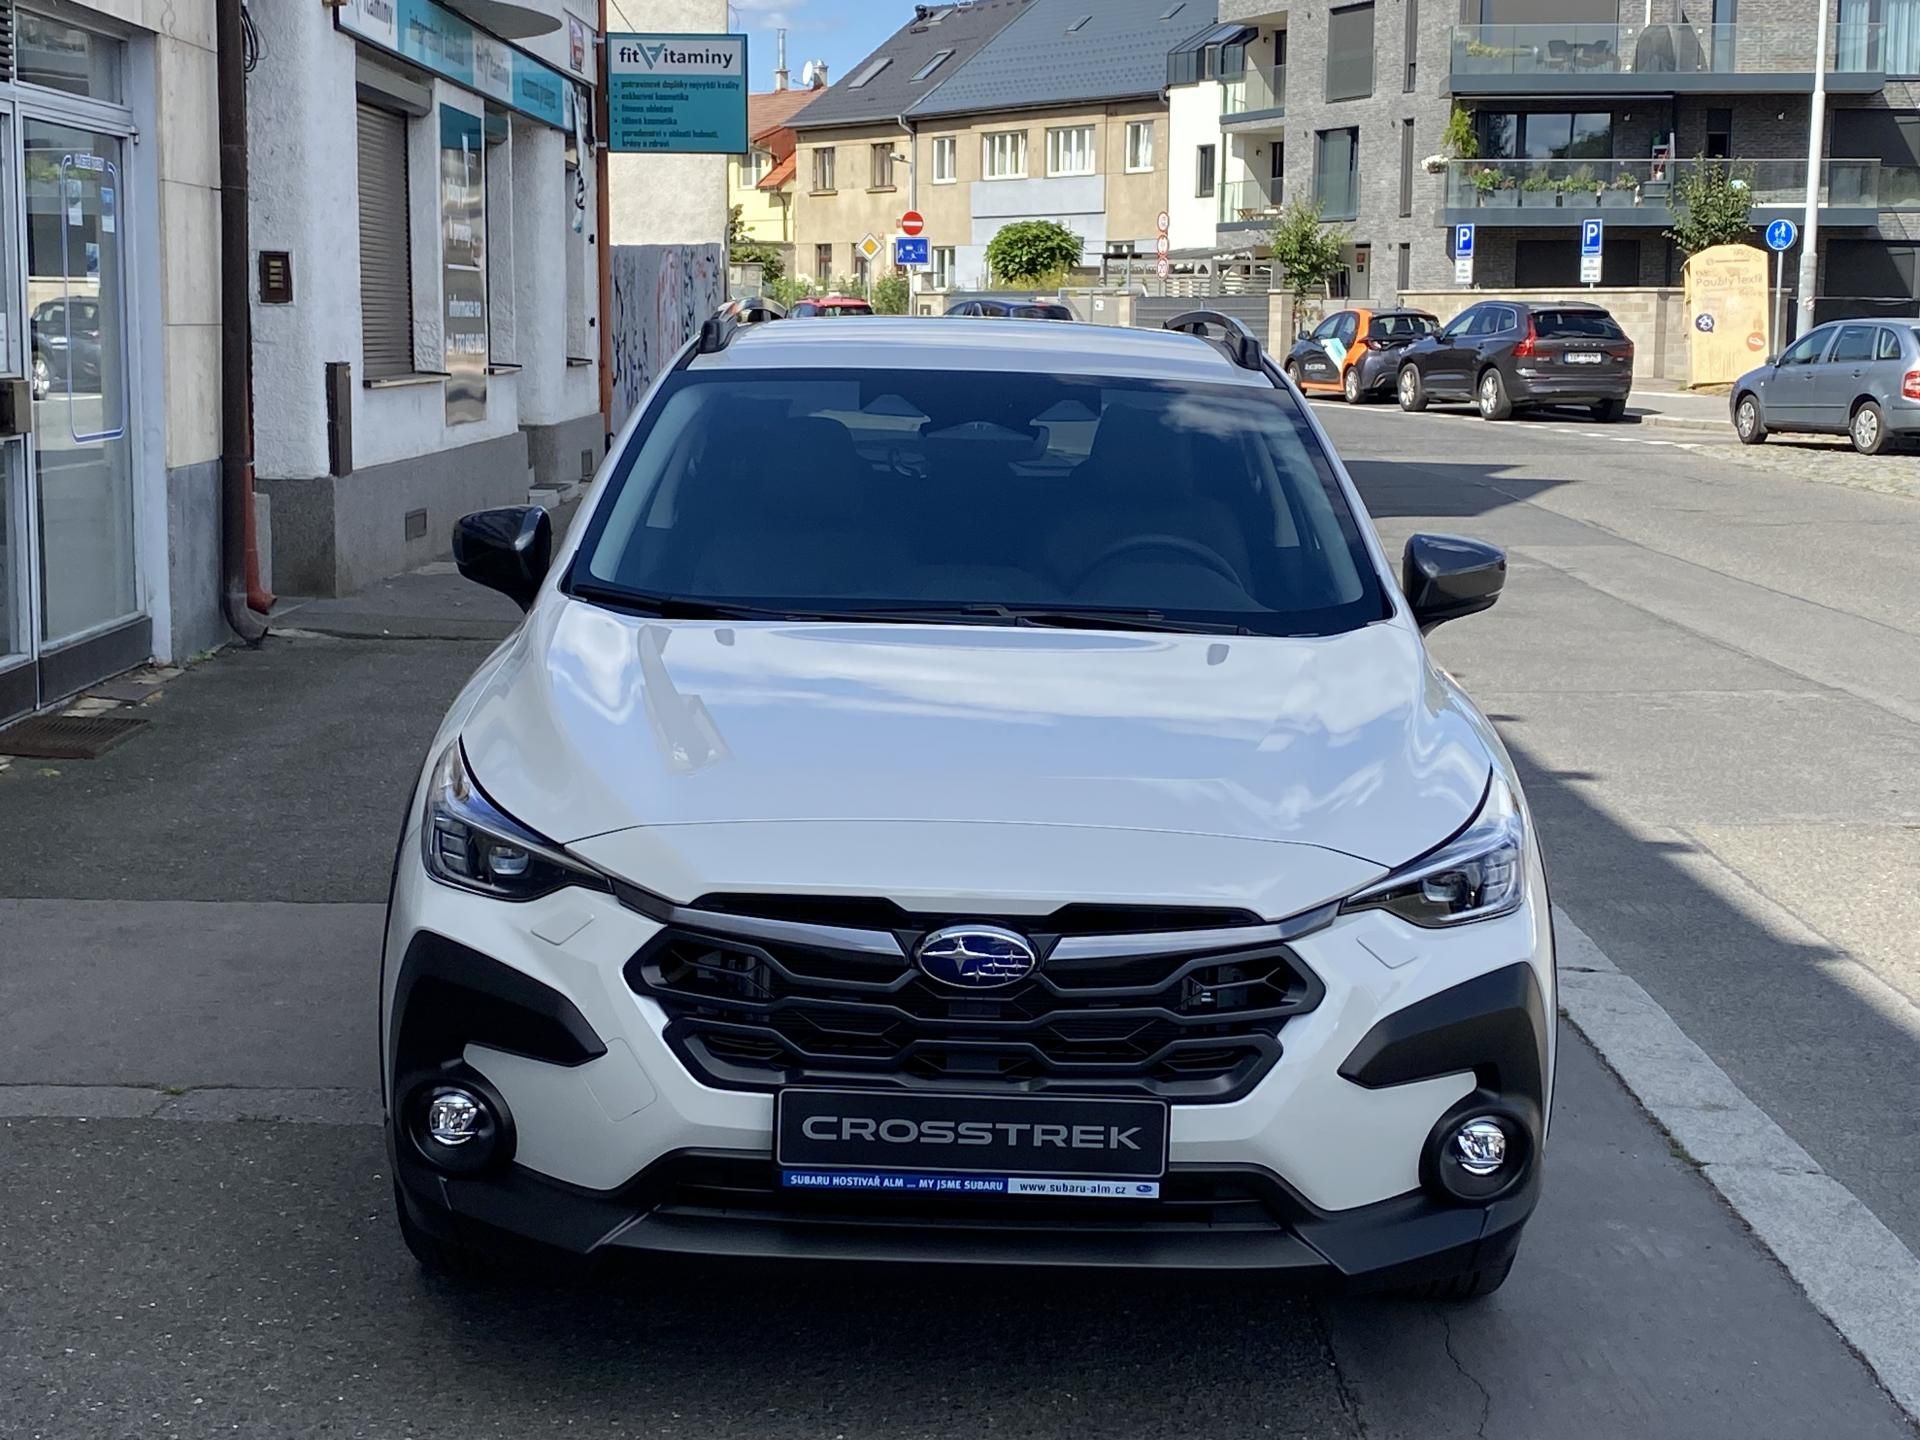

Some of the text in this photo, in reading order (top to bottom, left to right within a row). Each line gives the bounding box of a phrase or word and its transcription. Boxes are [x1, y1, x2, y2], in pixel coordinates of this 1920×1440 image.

[1459, 228, 1470, 248] P
[1586, 223, 1598, 245] P
[802, 1116, 1142, 1150] CROSSTREK
[790, 1175, 830, 1186] SUBARU
[832, 1176, 880, 1187] HOSTIVAŘ
[883, 1179, 904, 1187] ALM
[918, 1180, 935, 1189] MY
[936, 1180, 961, 1190] JSME
[964, 1181, 1003, 1190] SUBARU
[1020, 1182, 1126, 1195] www.subaru-alm.cz
